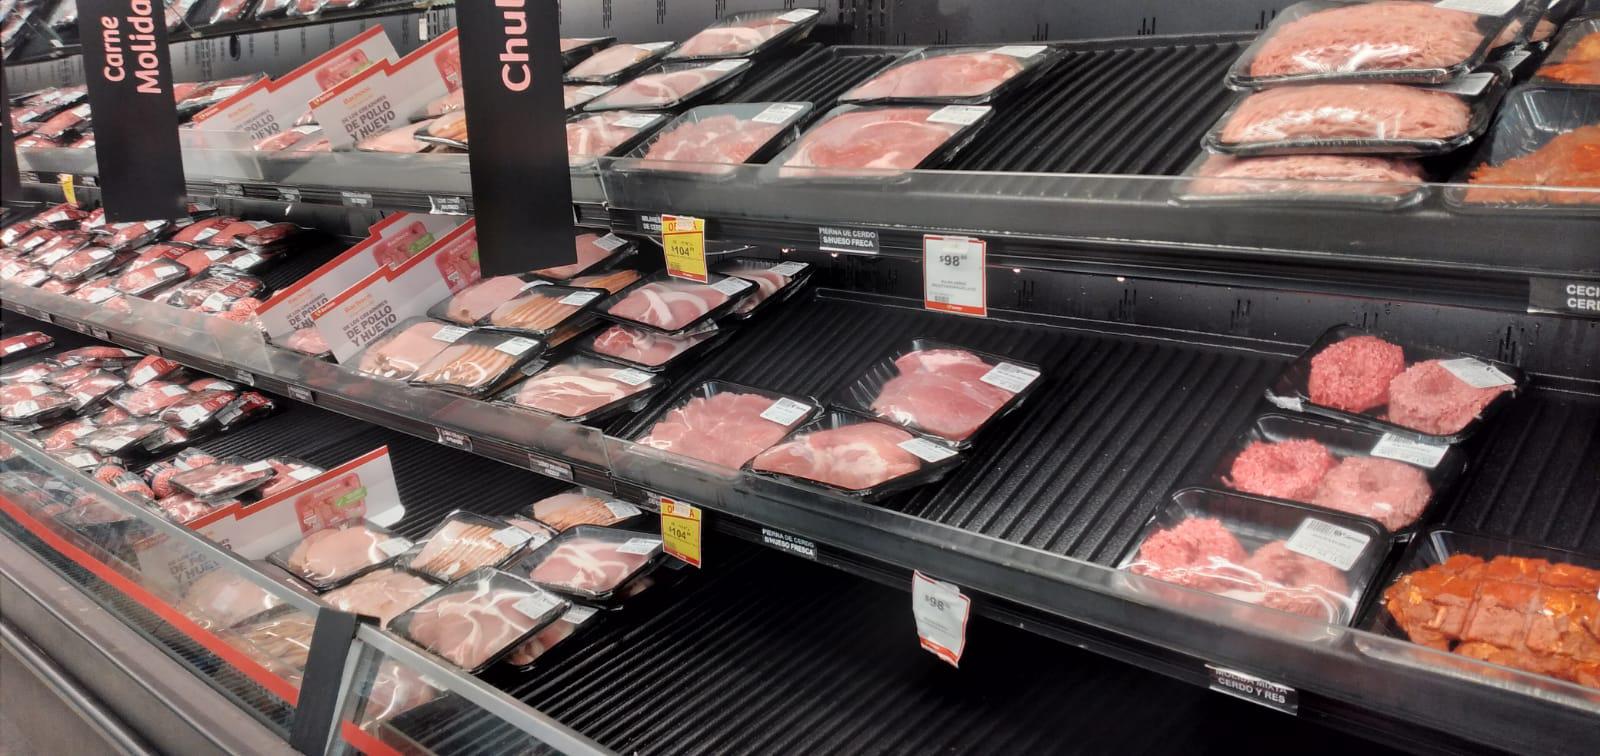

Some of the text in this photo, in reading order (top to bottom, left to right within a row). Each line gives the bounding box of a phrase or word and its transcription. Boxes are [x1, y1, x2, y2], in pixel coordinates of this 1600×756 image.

[101, 16, 126, 82] Carne
[126, 0, 162, 93] Molida
[345, 120, 360, 133] DE
[360, 101, 391, 124] POLLO
[350, 132, 359, 141] Y
[360, 110, 396, 138] HUEVO
[819, 226, 842, 236] PIERNA
[853, 230, 876, 239] CERDO
[1566, 284, 1600, 298] CECI
[288, 314, 302, 326] DE
[346, 326, 361, 340] DE
[360, 304, 392, 330] POLLO
[351, 338, 361, 348] Y
[360, 312, 397, 342] HUEVO
[784, 534, 793, 542] DE
[1217, 676, 1286, 704] CERDO Y RES
